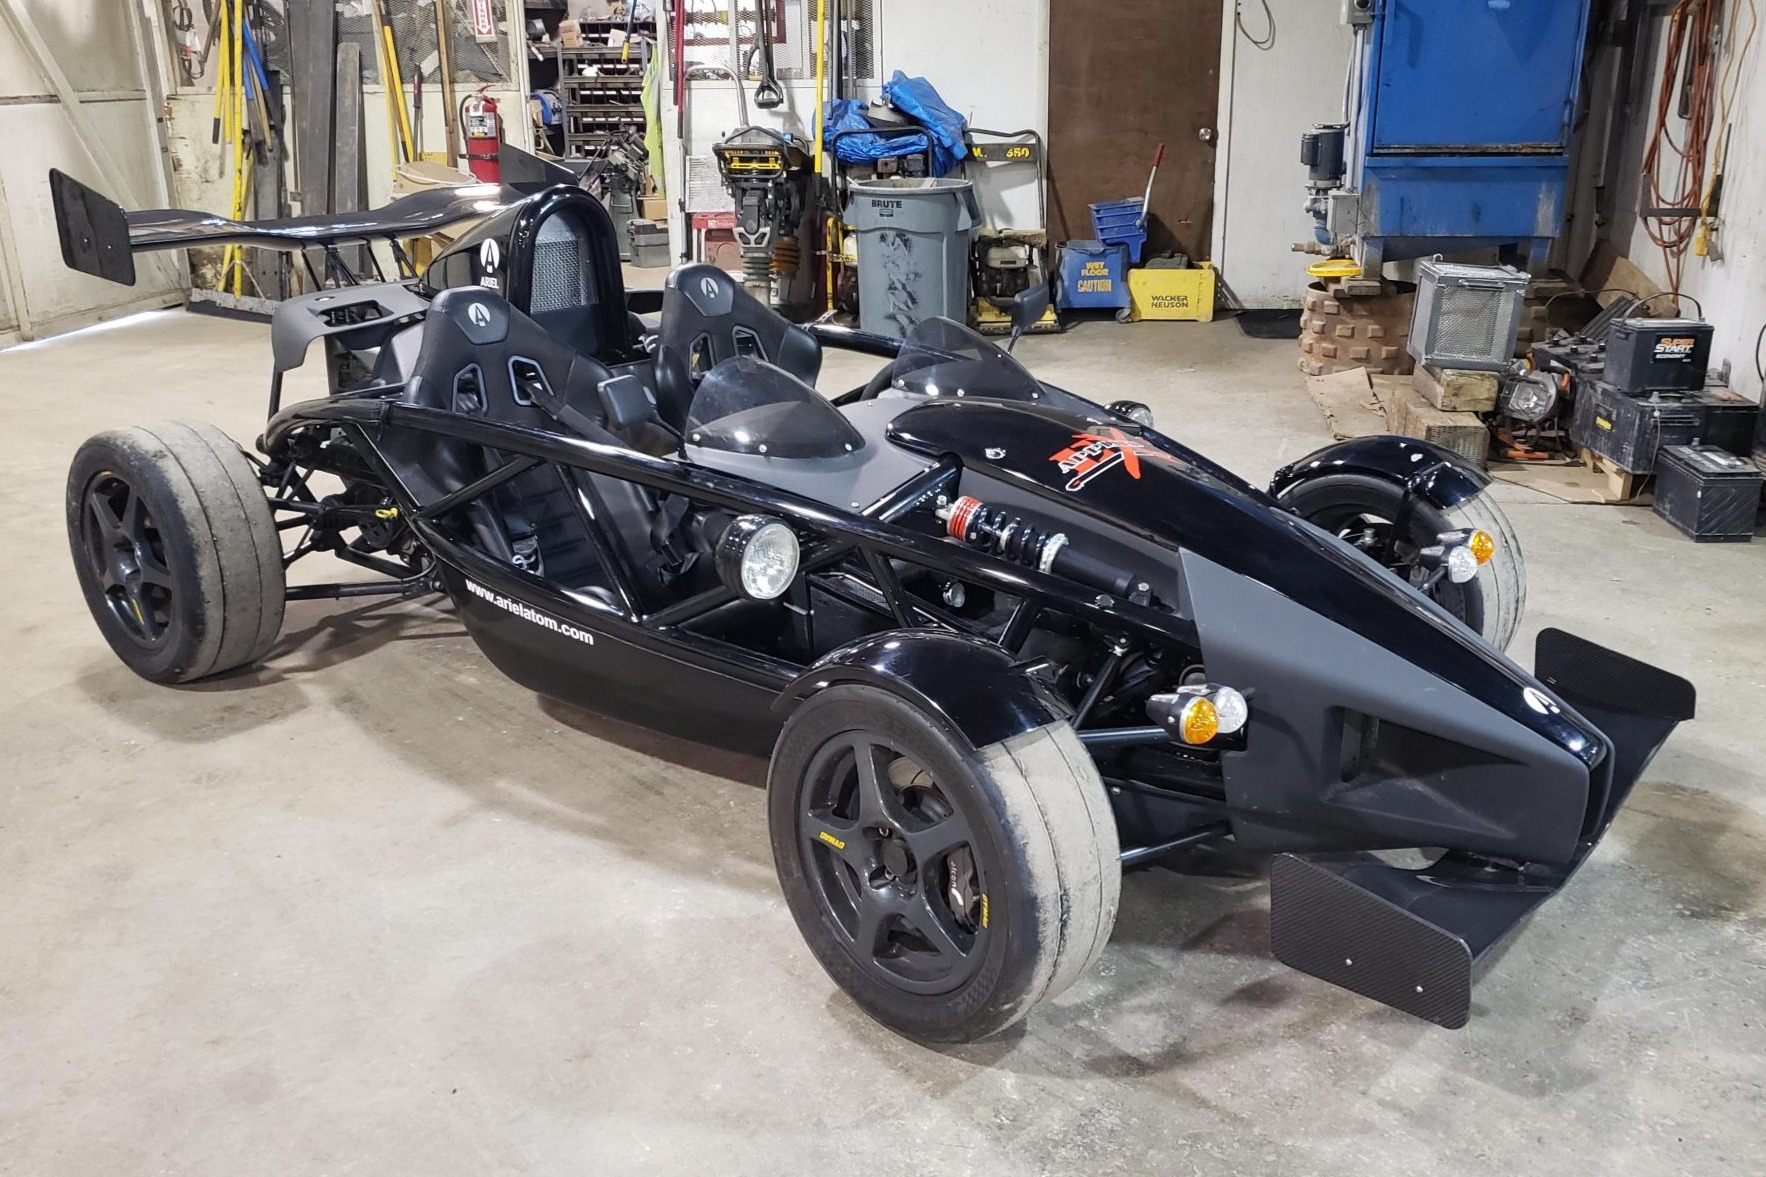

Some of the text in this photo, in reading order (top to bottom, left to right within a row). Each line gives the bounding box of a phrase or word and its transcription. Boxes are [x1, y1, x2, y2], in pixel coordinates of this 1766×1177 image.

[871, 199, 903, 209] BRUTE
[1085, 261, 1105, 270] WET
[1081, 268, 1109, 276] FLOOR
[1077, 279, 1112, 293] CAUTION
[1660, 337, 1695, 346] SUPER
[1653, 343, 1695, 353] START
[465, 579, 594, 645] www.arielatom.com
